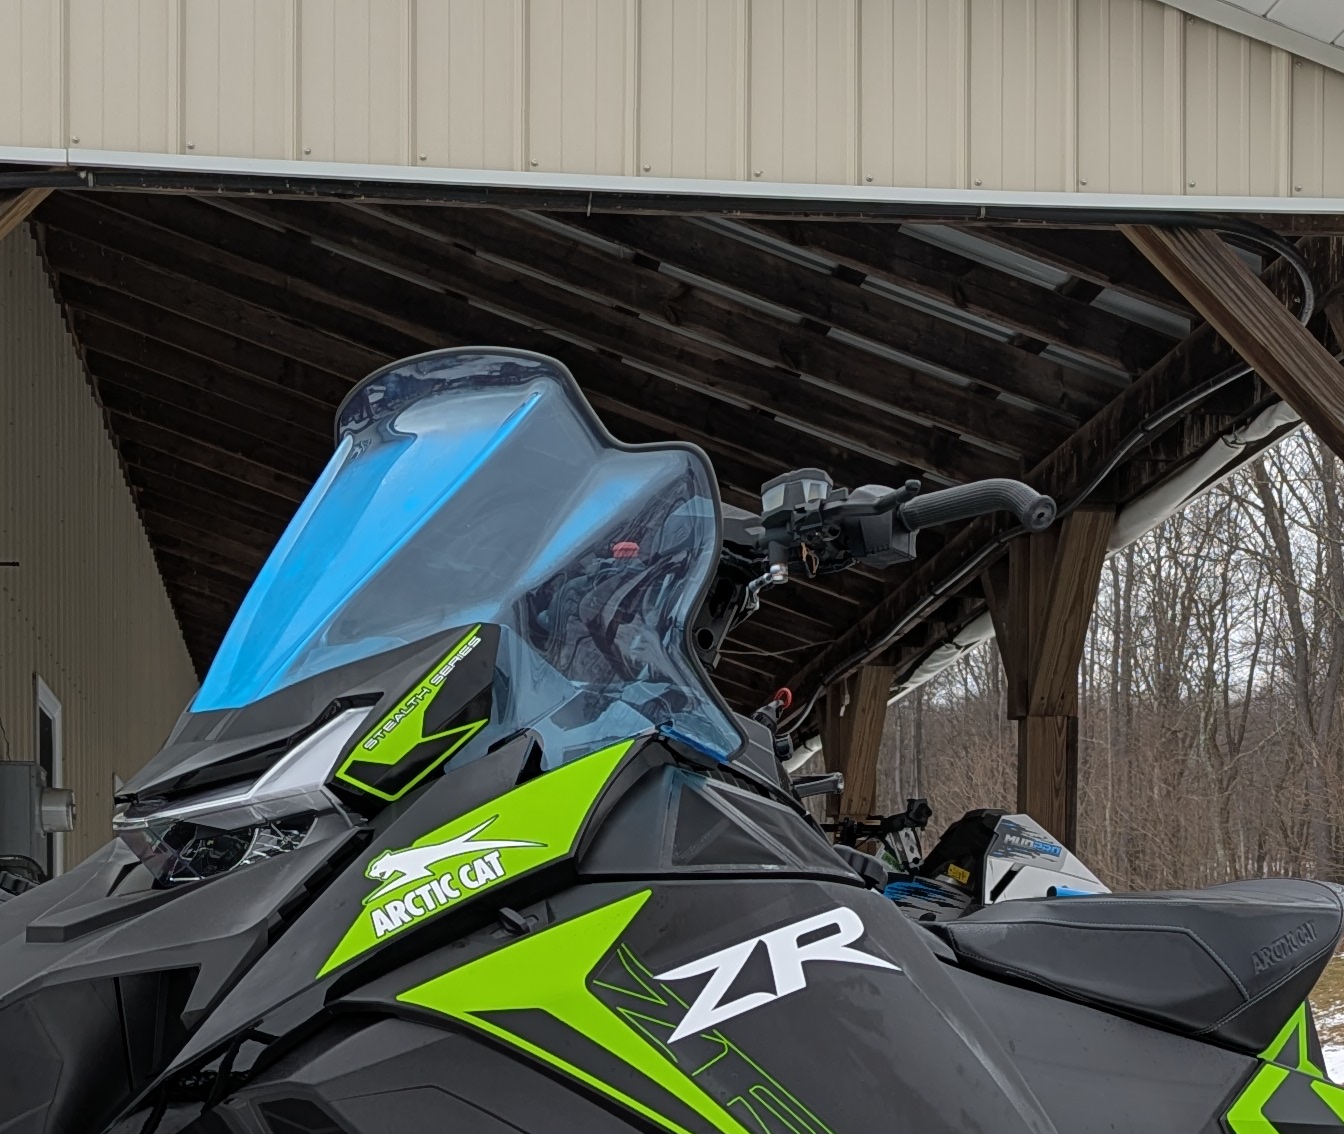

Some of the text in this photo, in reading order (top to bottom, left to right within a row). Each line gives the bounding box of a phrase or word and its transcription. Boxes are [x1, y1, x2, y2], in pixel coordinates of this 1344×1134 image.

[364, 635, 482, 750] STEALTH SERIES
[371, 850, 506, 938] ARCTIC CAT
[653, 906, 902, 1044] ZR
[1251, 919, 1318, 975] ARCTIC CAT
